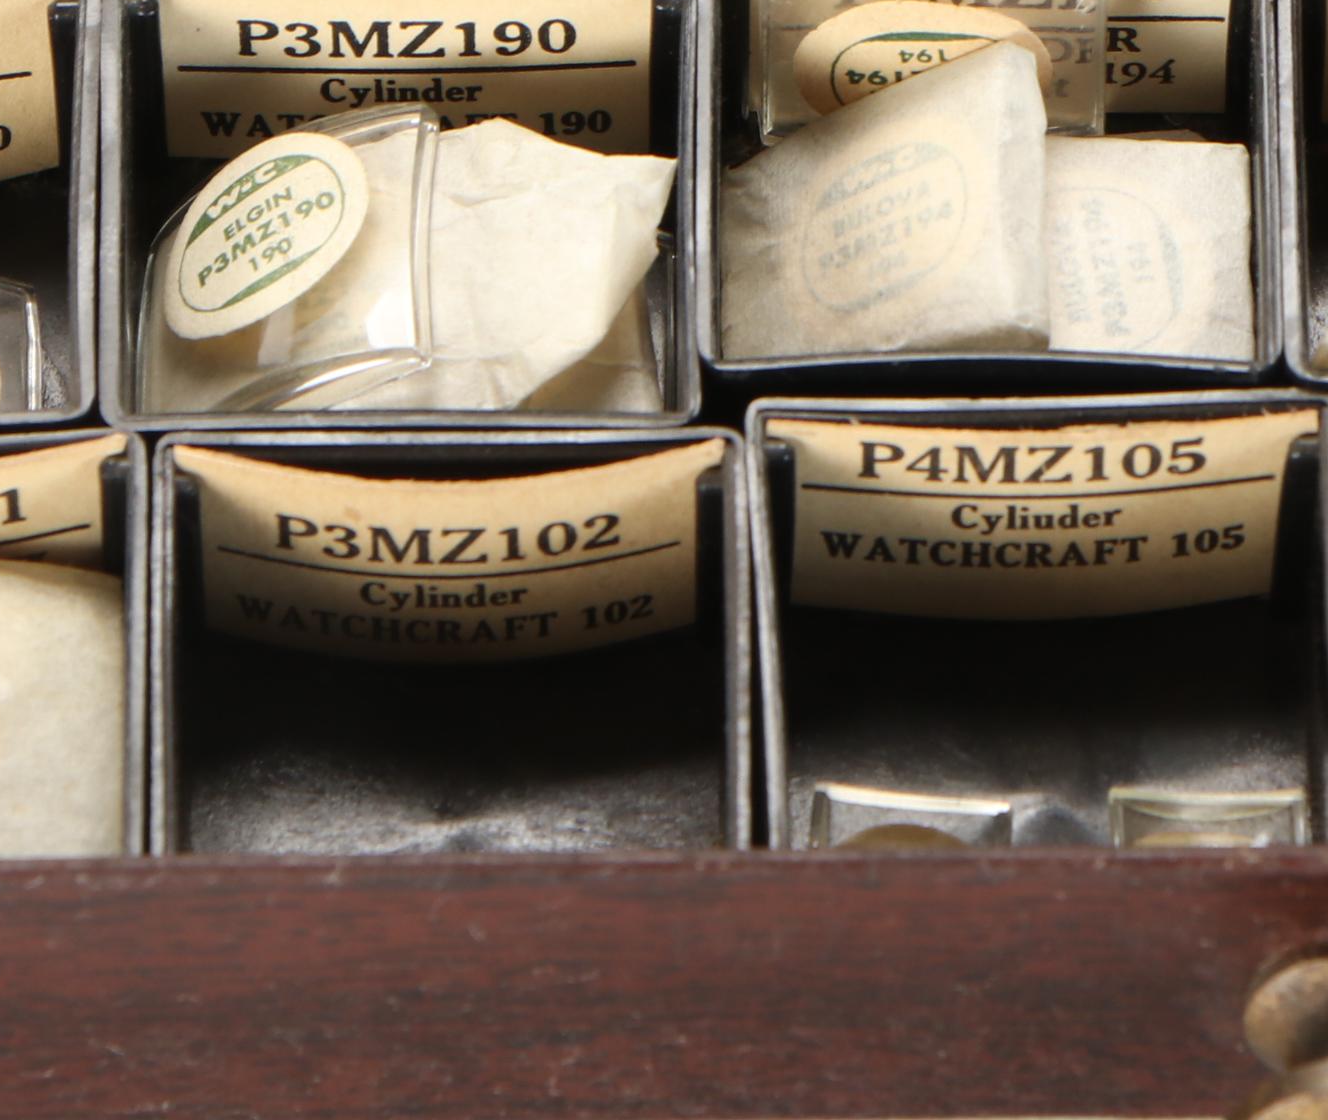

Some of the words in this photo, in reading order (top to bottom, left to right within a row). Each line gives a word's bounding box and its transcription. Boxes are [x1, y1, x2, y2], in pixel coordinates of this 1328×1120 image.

[236, 18, 578, 59] P3MZ190
[319, 78, 484, 109] Cylinder
[538, 110, 613, 137] 190
[223, 185, 294, 242] ELGIN
[197, 191, 335, 288] P3MZ190
[248, 236, 294, 272] 190
[857, 436, 1208, 484] P4MZ105
[275, 513, 622, 566] P3MZ102
[820, 530, 1149, 569] WATCHCRAFT
[1171, 524, 1246, 559] 105
[235, 593, 558, 645] WATCHCRAFT
[581, 593, 655, 630] 102
[359, 581, 529, 612] Cylinder
